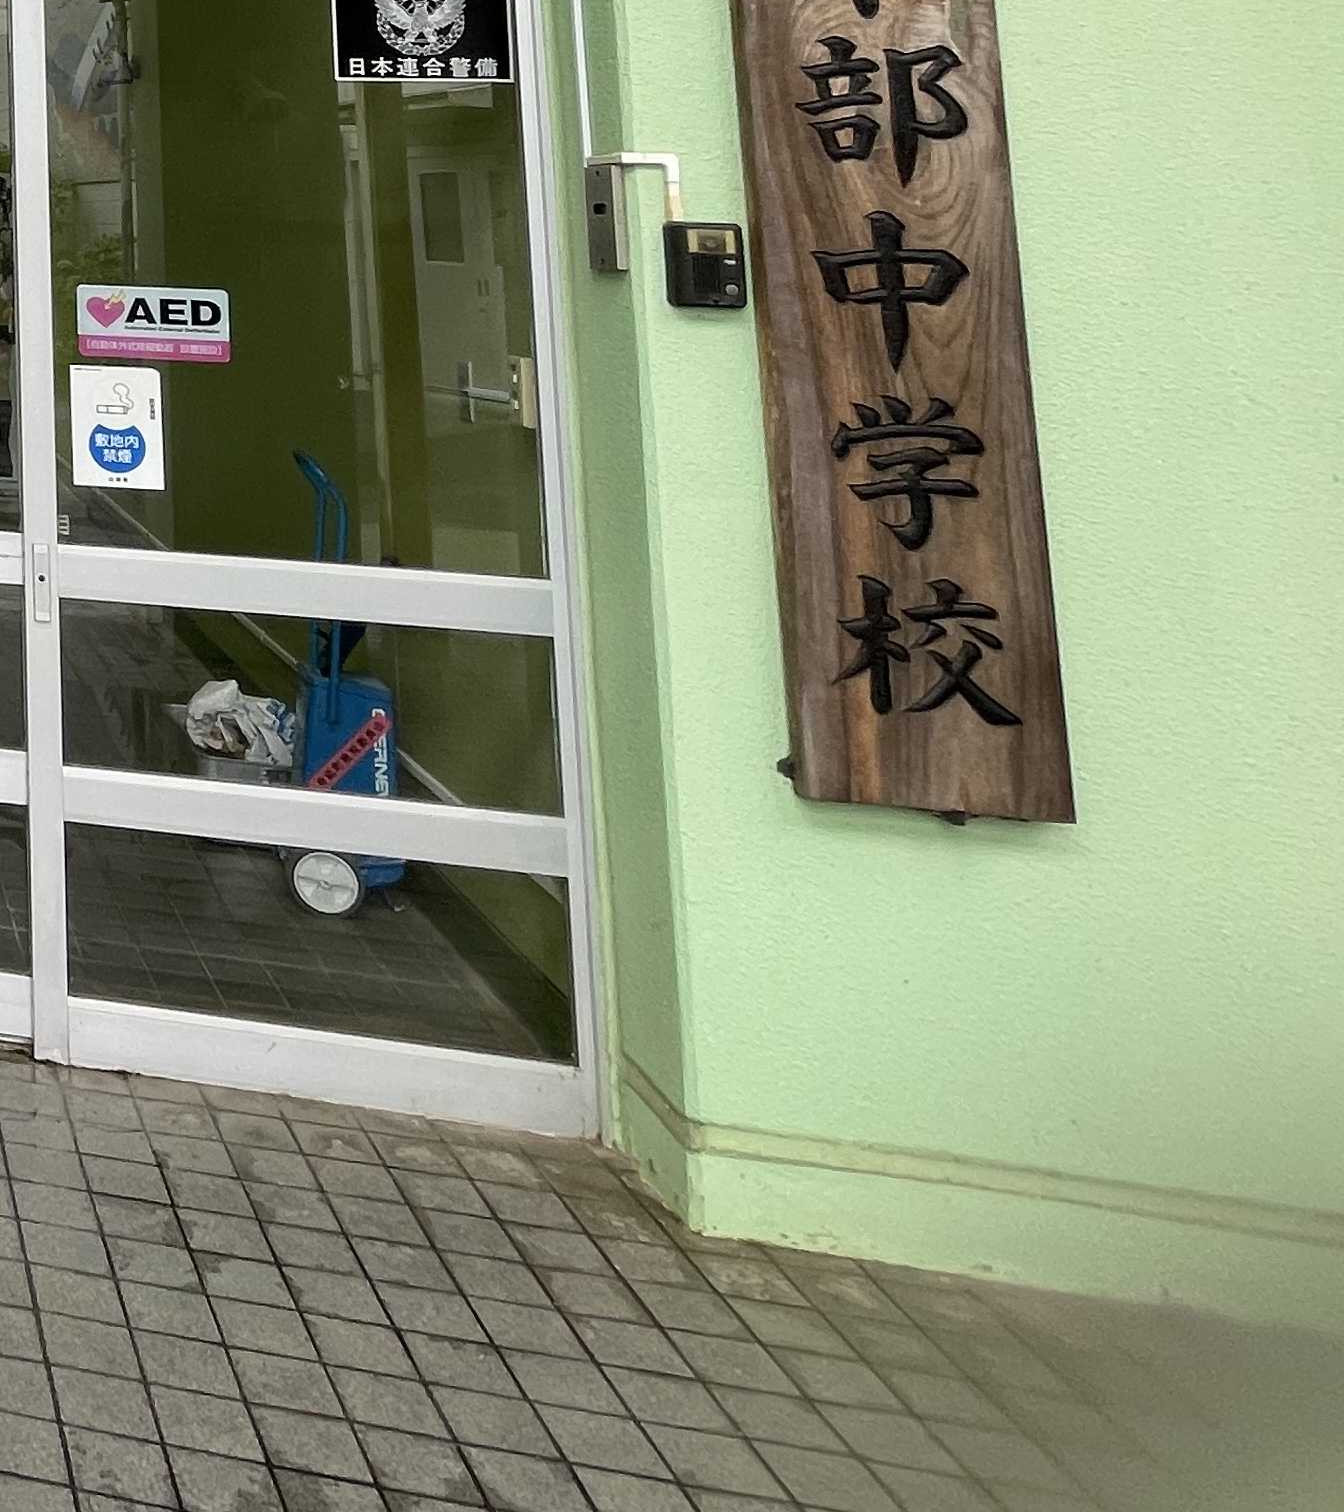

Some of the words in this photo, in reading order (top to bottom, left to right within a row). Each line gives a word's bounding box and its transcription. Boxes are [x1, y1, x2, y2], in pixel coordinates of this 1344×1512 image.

[348, 56, 499, 78] 日本連合警備
[124, 297, 222, 327] AED
[95, 433, 140, 450] 敷地内
